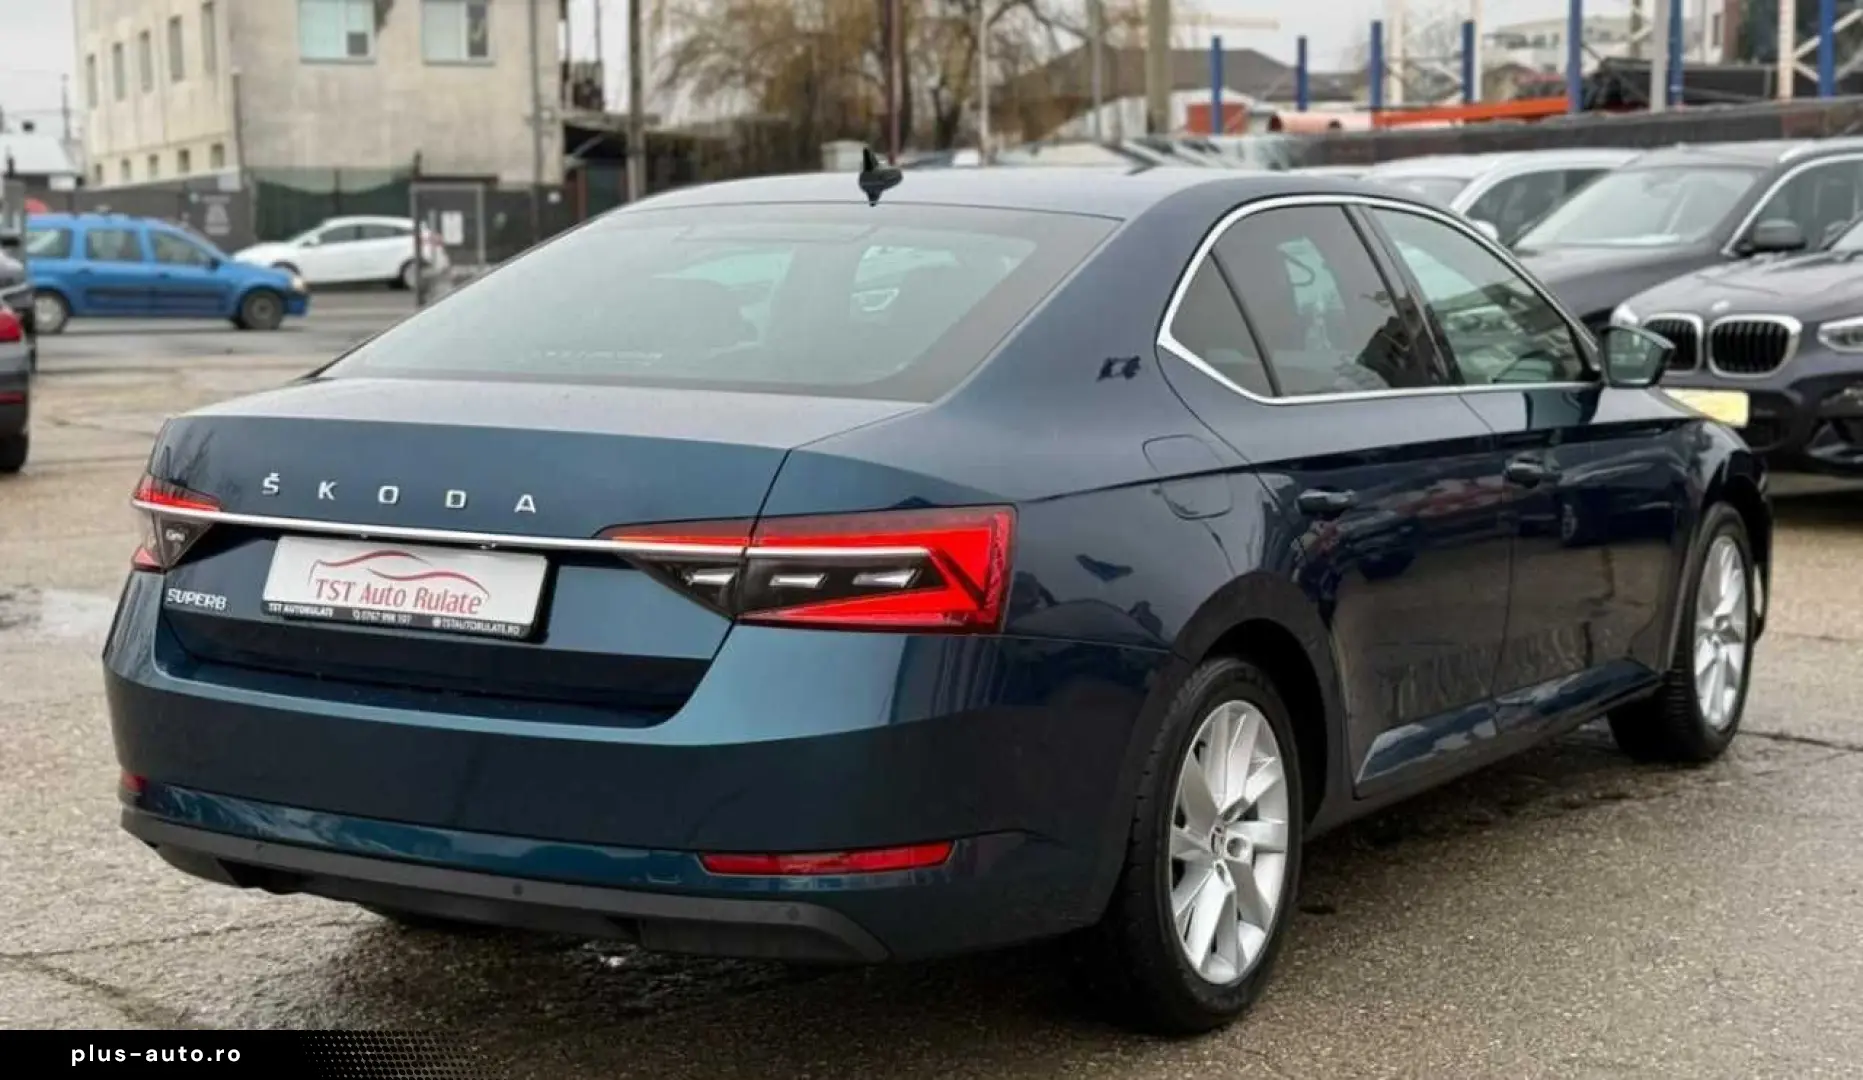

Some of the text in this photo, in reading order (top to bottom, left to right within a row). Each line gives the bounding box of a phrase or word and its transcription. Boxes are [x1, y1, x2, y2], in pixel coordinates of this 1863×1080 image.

[262, 472, 536, 513] ŠKODA
[166, 587, 228, 611] SUPERB
[315, 578, 482, 615] TST Auto Rulate
